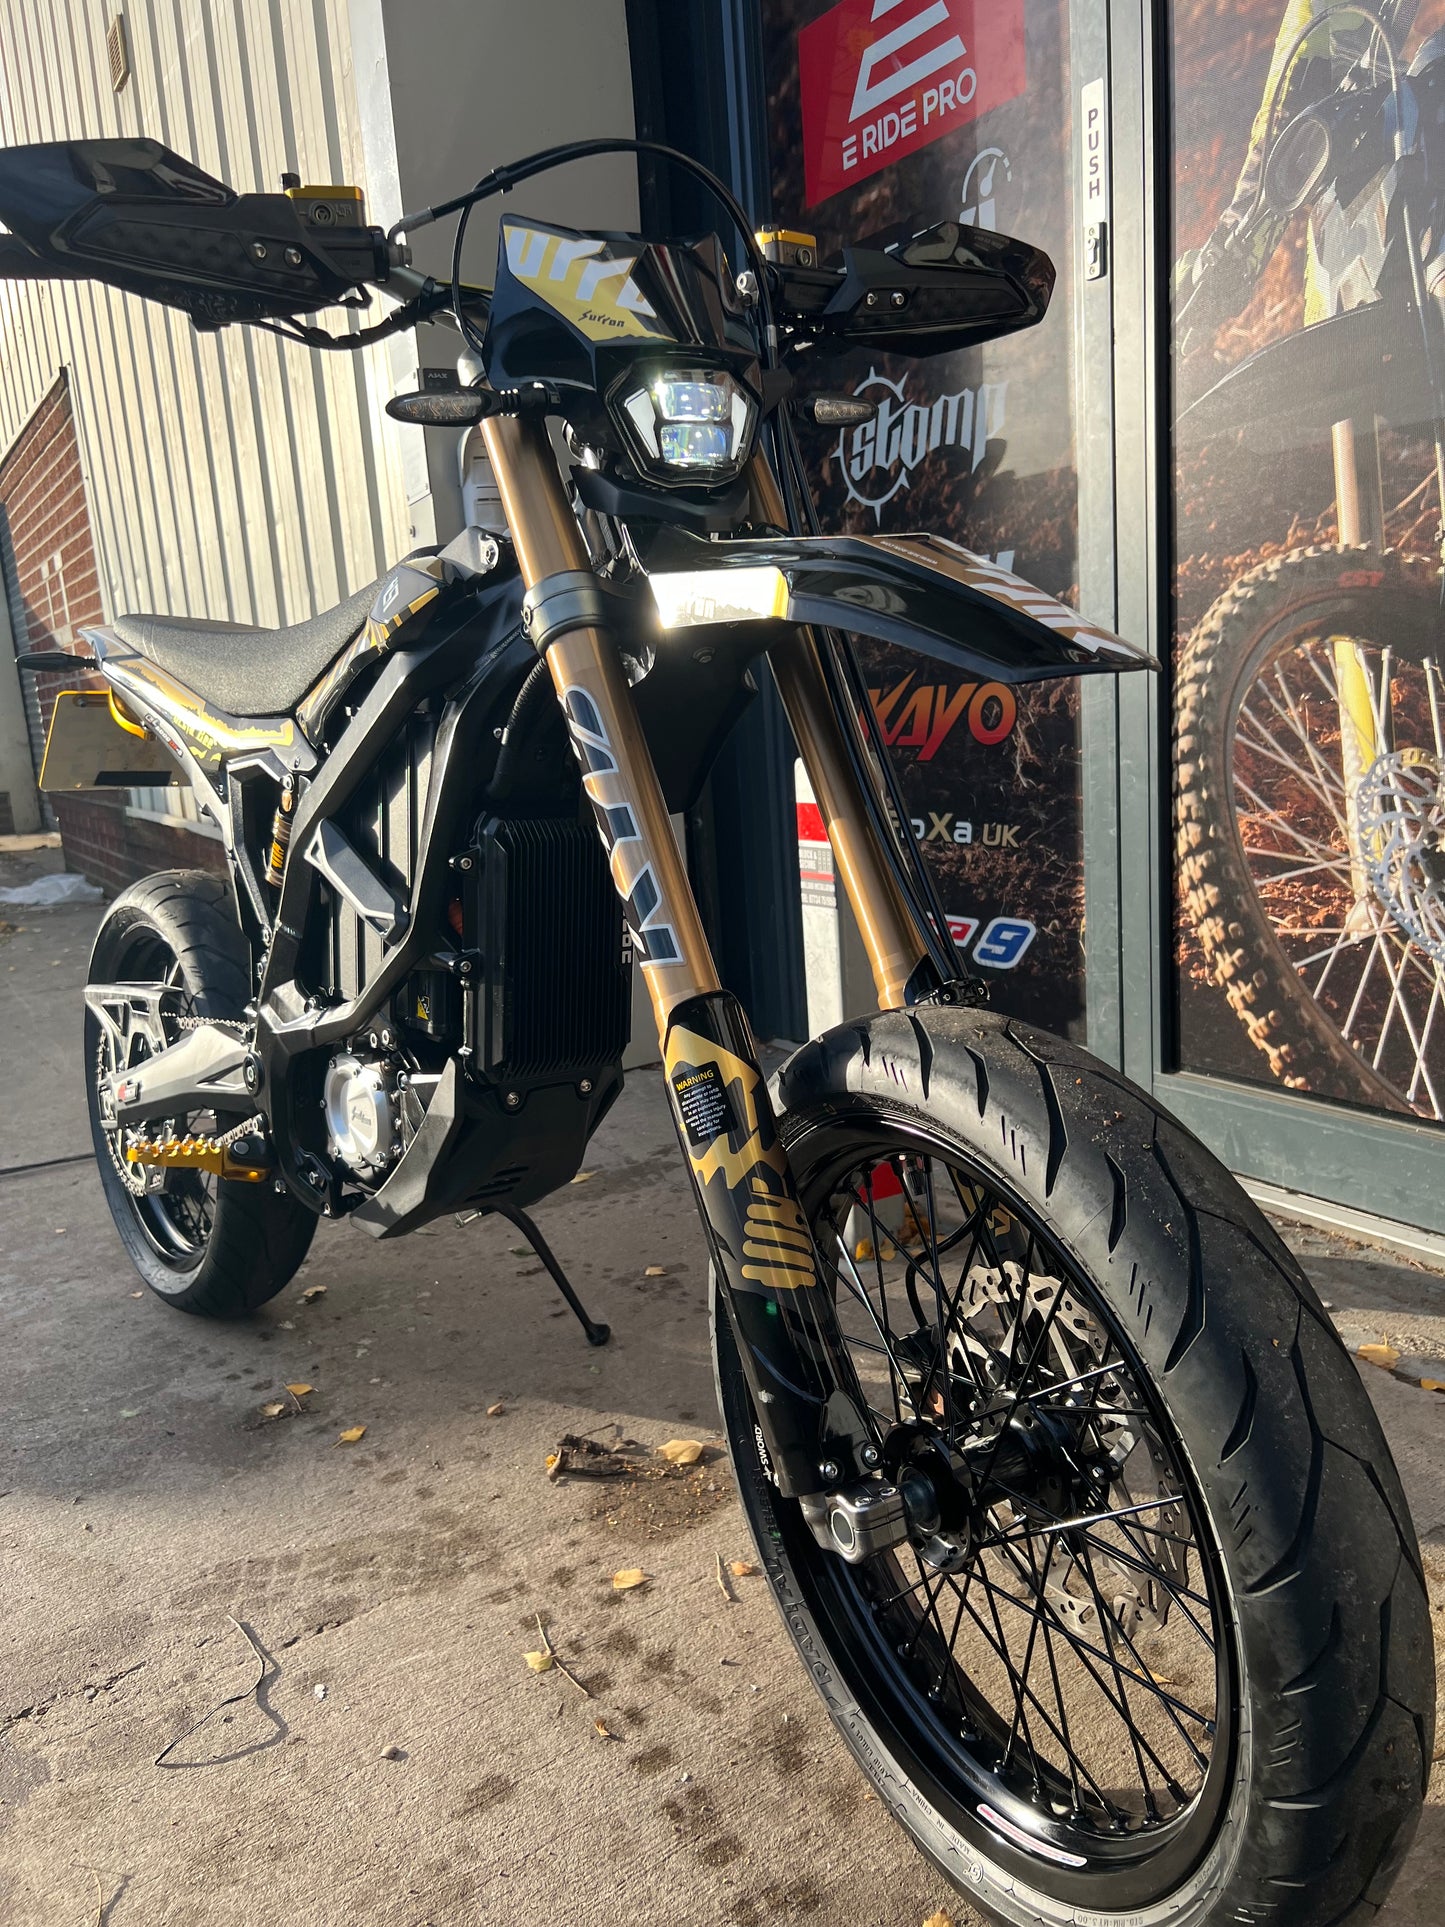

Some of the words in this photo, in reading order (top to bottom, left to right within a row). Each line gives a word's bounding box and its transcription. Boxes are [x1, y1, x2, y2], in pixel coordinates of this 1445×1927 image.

[842, 134, 858, 171] E
[862, 99, 917, 159] RIDE
[922, 67, 977, 126] PRO
[1087, 107, 1101, 200] PUSH
[578, 310, 625, 328] Surron
[859, 668, 1017, 761] KAYO
[982, 820, 1020, 848] UK
[676, 1069, 714, 1092] WARNING
[754, 1426, 769, 1465] SWORD
[766, 1555, 833, 1686] RADIAL
[911, 1789, 932, 1816] CHINA
[936, 1819, 945, 1830] IN
